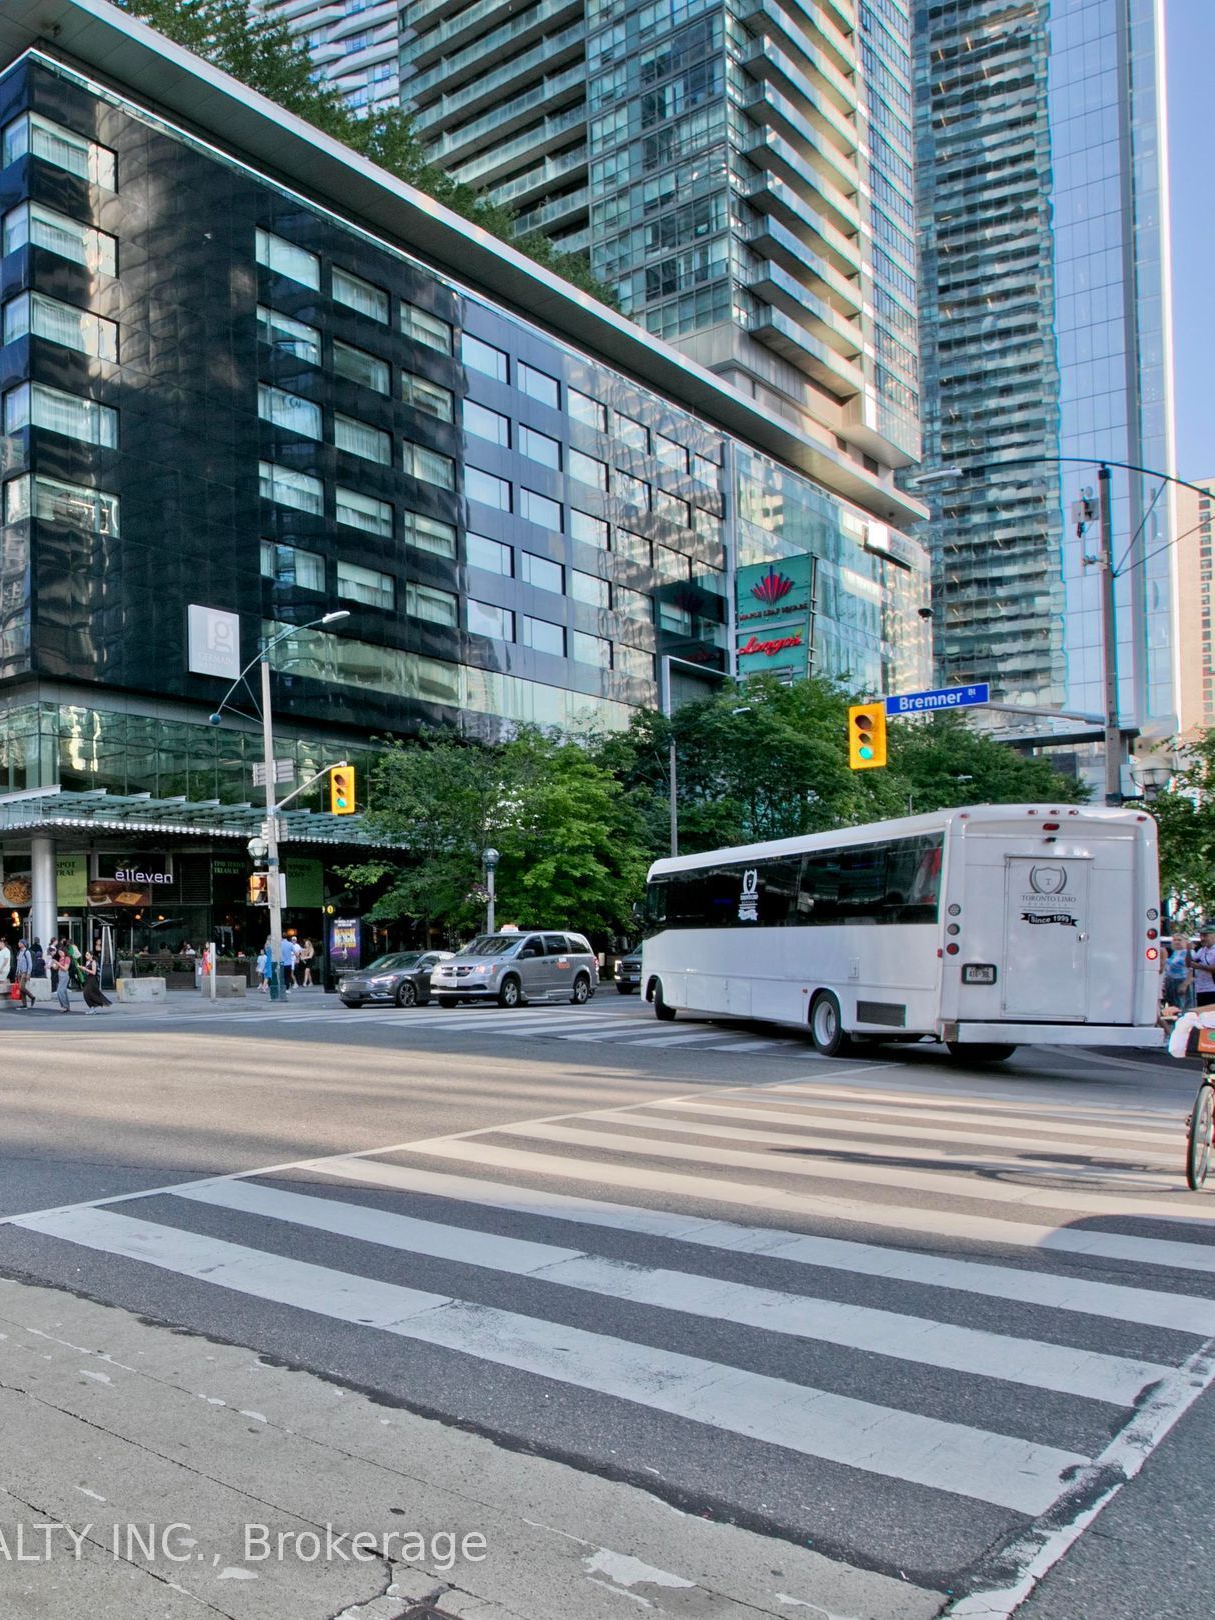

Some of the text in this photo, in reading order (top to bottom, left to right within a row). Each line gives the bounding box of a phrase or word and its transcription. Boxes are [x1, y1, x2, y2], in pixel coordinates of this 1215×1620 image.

[899, 692, 963, 710] Bremner
[115, 869, 173, 884] elleven
[1030, 916, 1051, 924] Since
